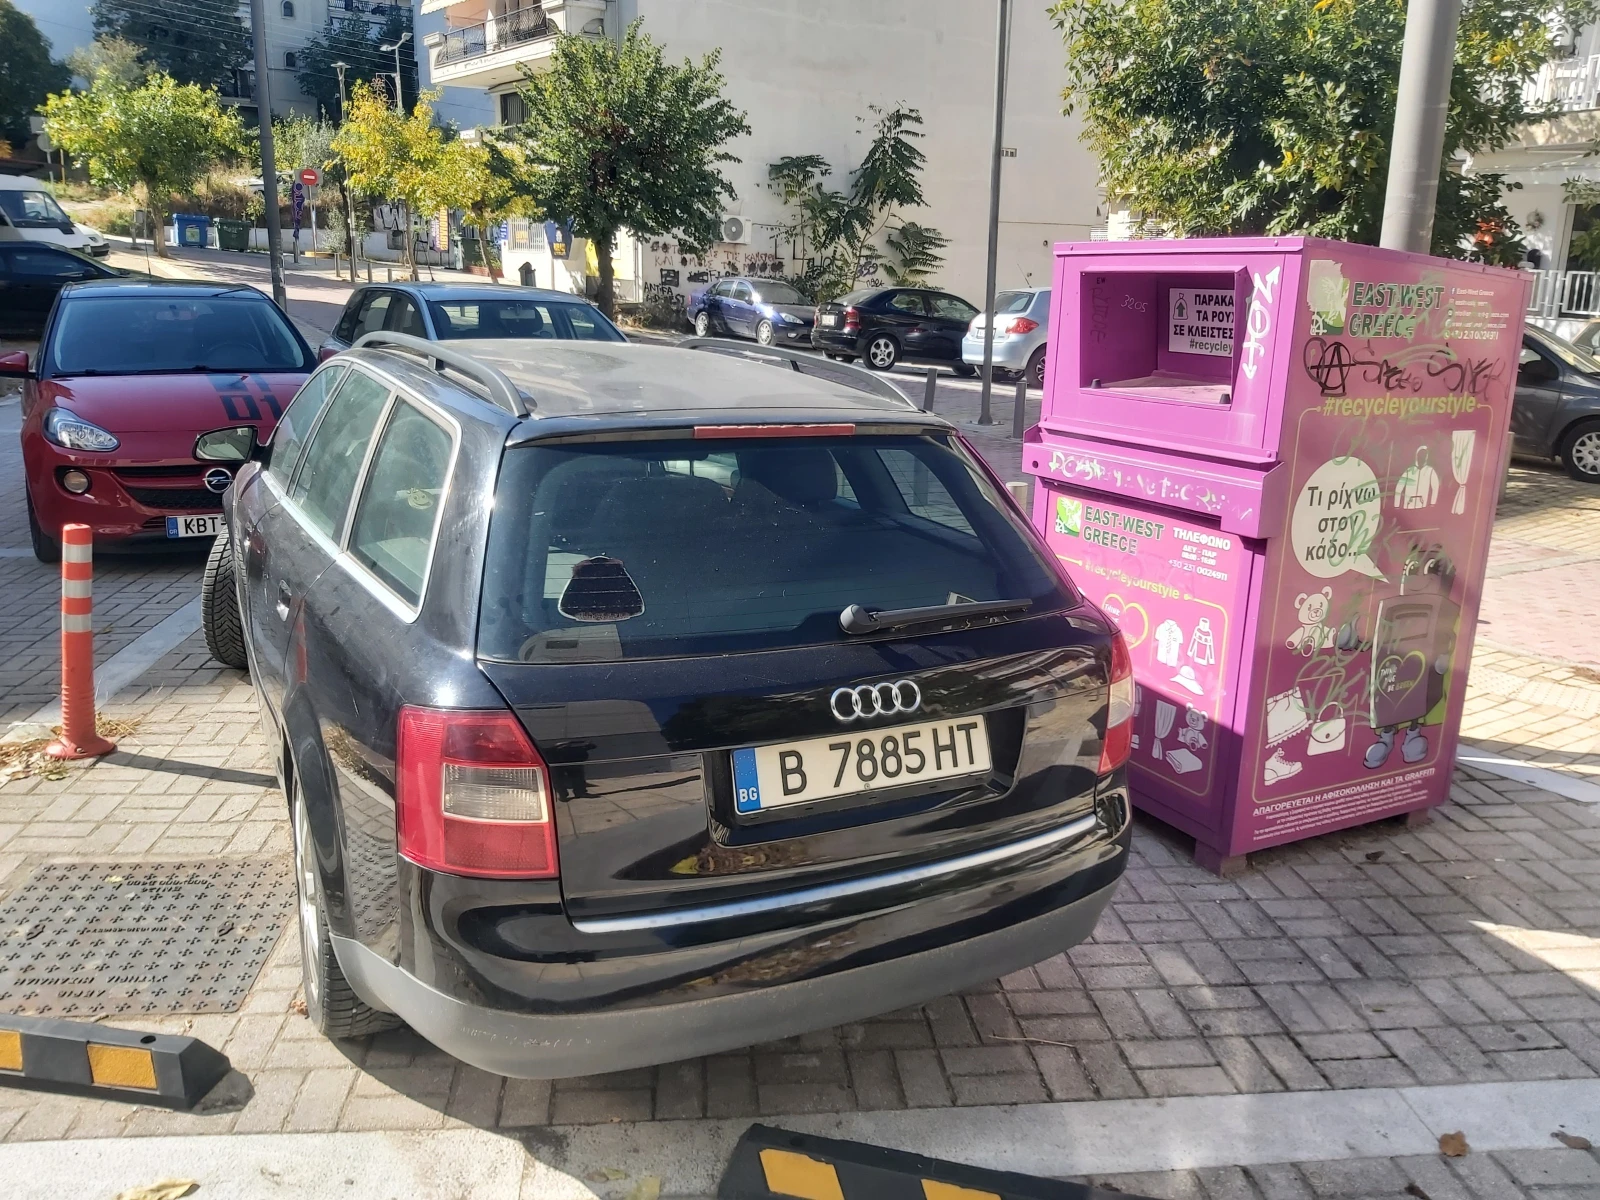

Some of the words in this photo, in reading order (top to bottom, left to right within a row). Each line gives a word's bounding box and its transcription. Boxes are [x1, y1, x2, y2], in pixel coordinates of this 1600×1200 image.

[1120, 294, 1149, 313] 3205
[1194, 293, 1234, 307] ΠΑΡΑΚΑ
[1196, 310, 1209, 322] ΤΑ
[1173, 324, 1185, 336] ΣΕ
[1187, 325, 1234, 340] ΚΛΕΙΣΤΕΣ
[1189, 338, 1234, 354] #recycley
[1323, 392, 1476, 420] #recycleyourstyle
[1307, 486, 1323, 507] Τι
[1327, 482, 1376, 511] ρίχνω
[1083, 505, 1165, 541] EAST-WEST
[1318, 515, 1359, 533] στον
[1083, 525, 1138, 556] GREECE
[1172, 526, 1232, 551] ΤΗΛΕΦΩΝΟ
[778, 750, 807, 797] B
[829, 730, 926, 788] 7885
[932, 722, 978, 771] HT
[739, 787, 758, 804] BG
[1252, 796, 1314, 816] ΑΠΑΓΟΡΕΥΕΤΑΙ
[1321, 780, 1380, 801] ΑΦΙΣΟΚΟΛΛΗΣΗ
[1380, 777, 1394, 788] ΚΑΙ
[1394, 775, 1404, 785] ΤΑ
[1404, 767, 1436, 783] GRAFFITI
